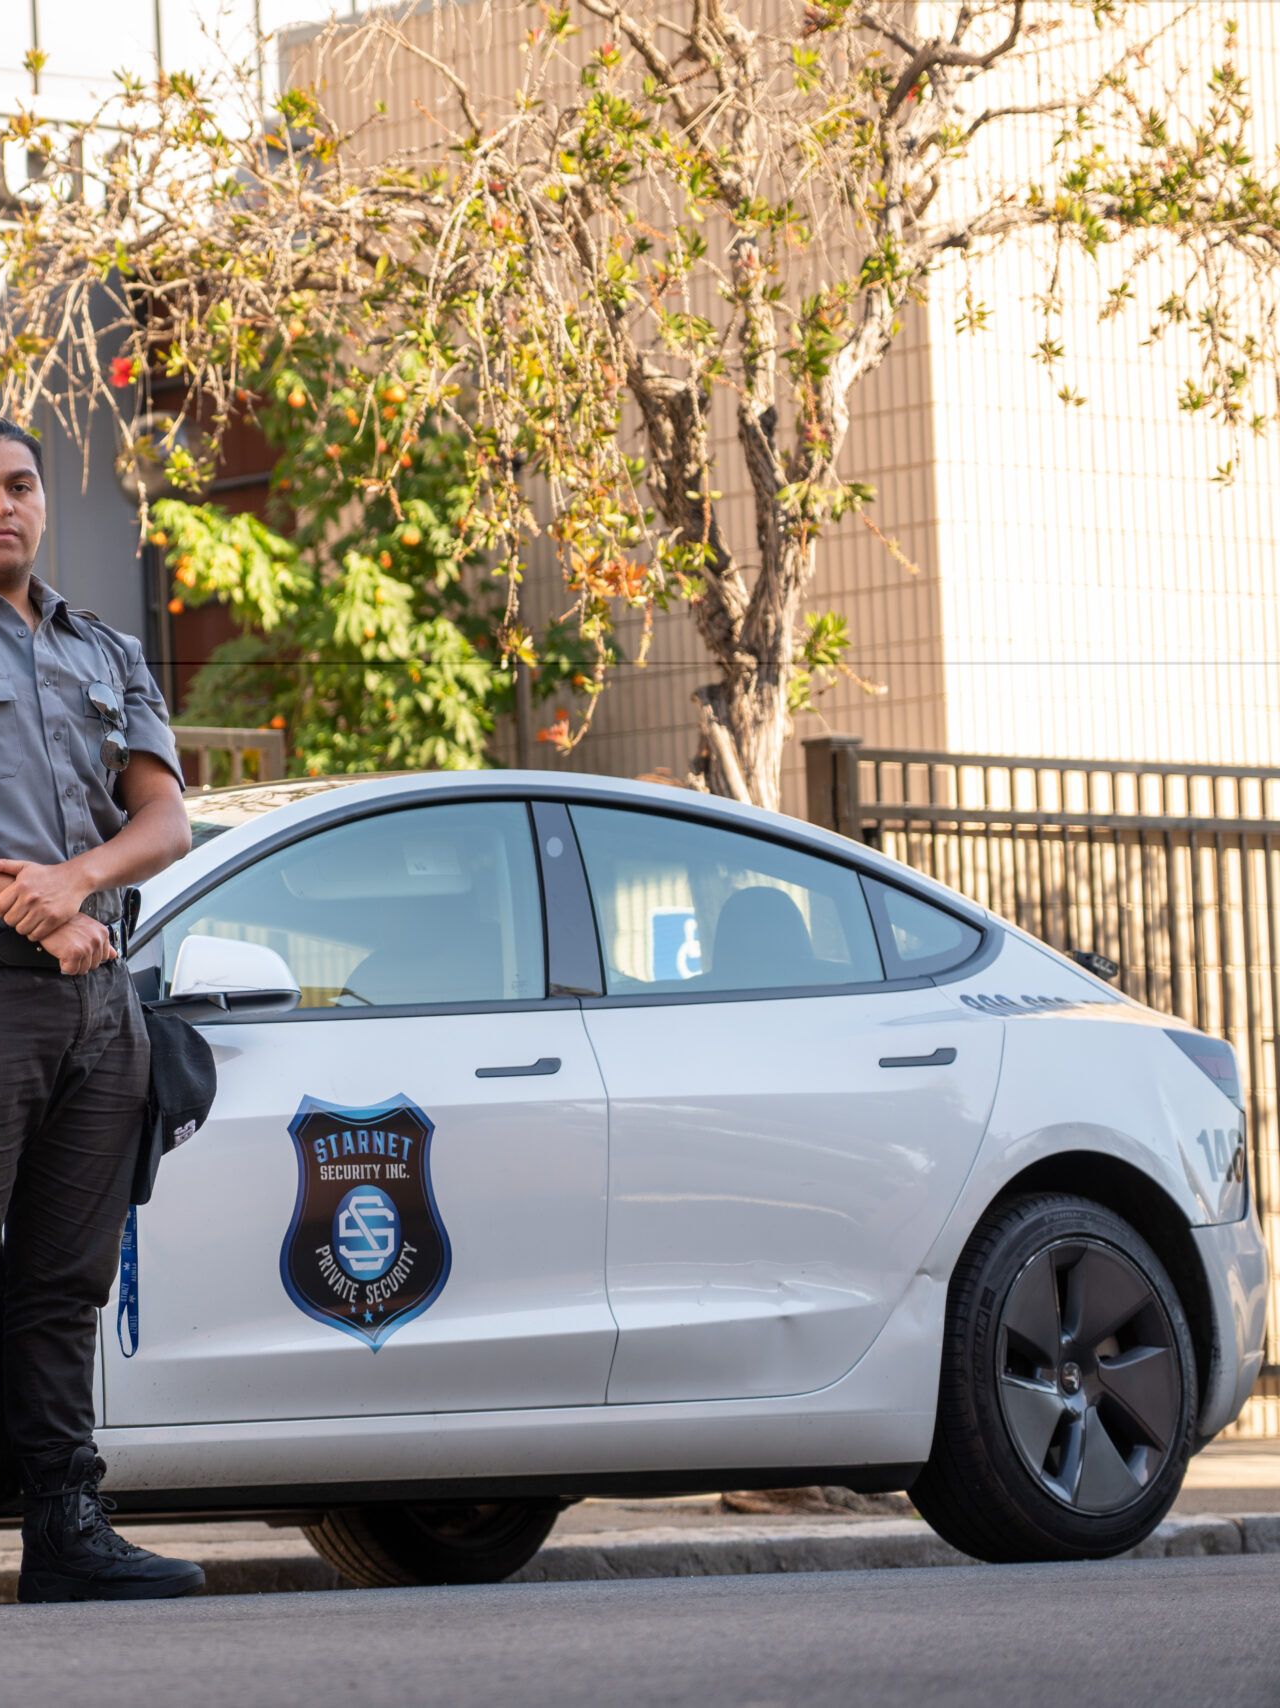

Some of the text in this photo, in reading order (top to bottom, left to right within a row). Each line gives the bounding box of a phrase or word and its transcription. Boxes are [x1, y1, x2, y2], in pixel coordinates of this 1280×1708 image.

[313, 1129, 414, 1164] STARNET
[320, 1163, 410, 1180] SECURITY INC.
[315, 1240, 418, 1305] PRIVATE SECURITY
